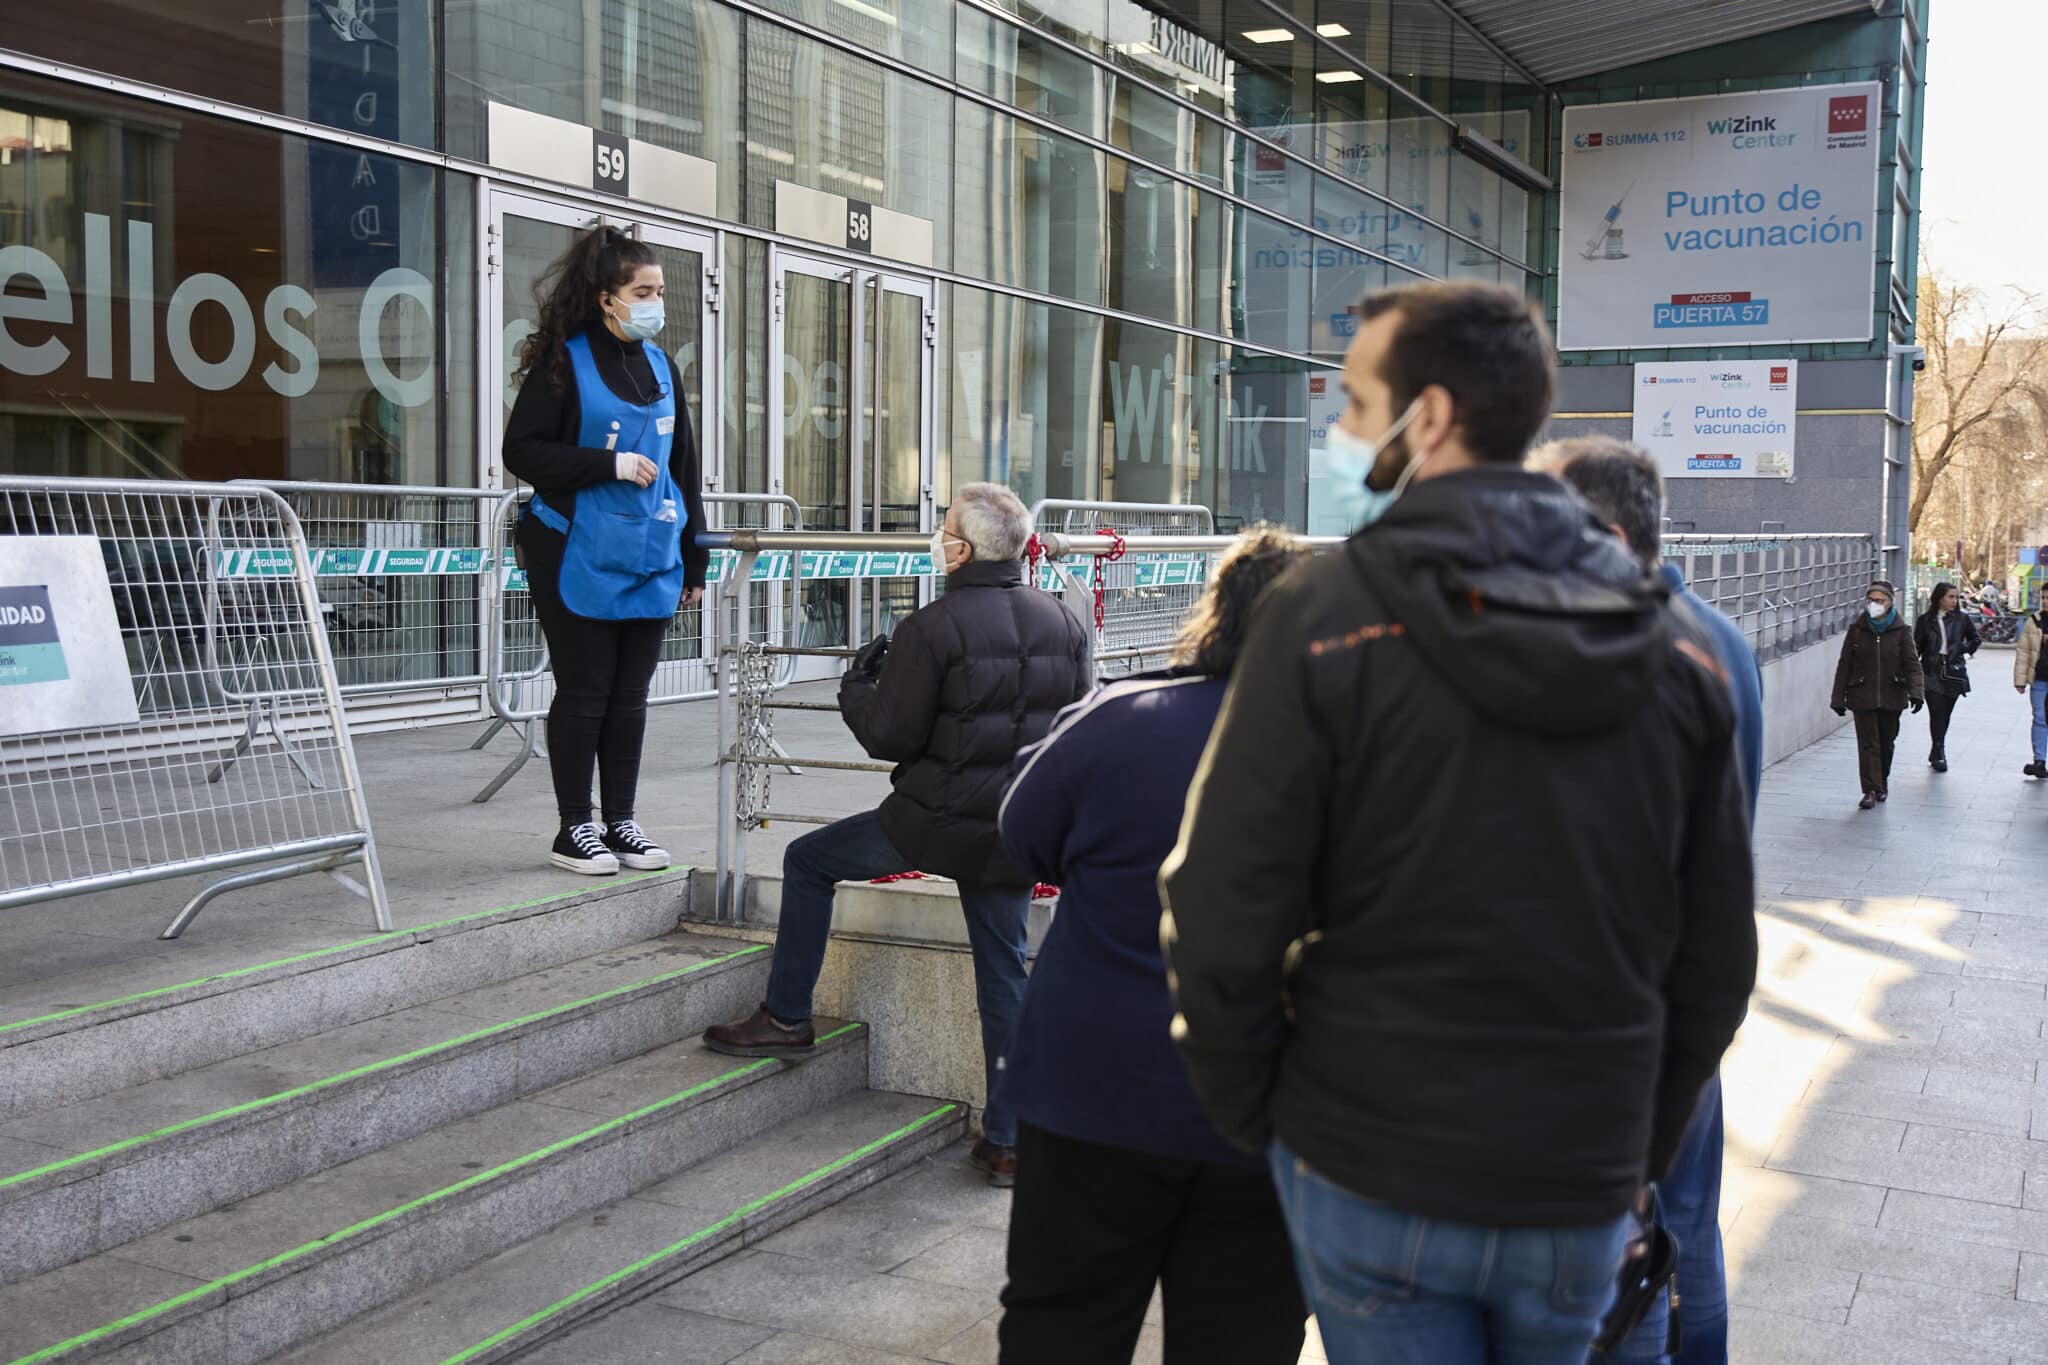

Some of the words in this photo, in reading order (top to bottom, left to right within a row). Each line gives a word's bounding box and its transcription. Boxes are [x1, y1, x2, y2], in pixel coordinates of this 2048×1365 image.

[1707, 116, 1776, 134] WiZink
[1606, 133, 1658, 146] SUMMA
[1664, 130, 1685, 142] 112
[1732, 132, 1796, 150] Center
[1839, 141, 1867, 149] Madrid
[597, 144, 625, 182] 59
[1666, 188, 1765, 218] Punto
[1777, 183, 1822, 212] de
[850, 211, 869, 240] 58
[1664, 214, 1863, 252] vacunación
[1690, 295, 1732, 304] ACCESO
[1657, 307, 1736, 324] PUERTA
[1742, 305, 1765, 321] 57
[1710, 372, 1742, 381] WiZink
[1695, 406, 1741, 419] Punto
[1746, 405, 1767, 418] de
[1694, 421, 1786, 434] vacunación
[1728, 460, 1739, 468] 57
[389, 557, 424, 566] SEGURIDAD
[0, 605, 46, 625] IDAD
